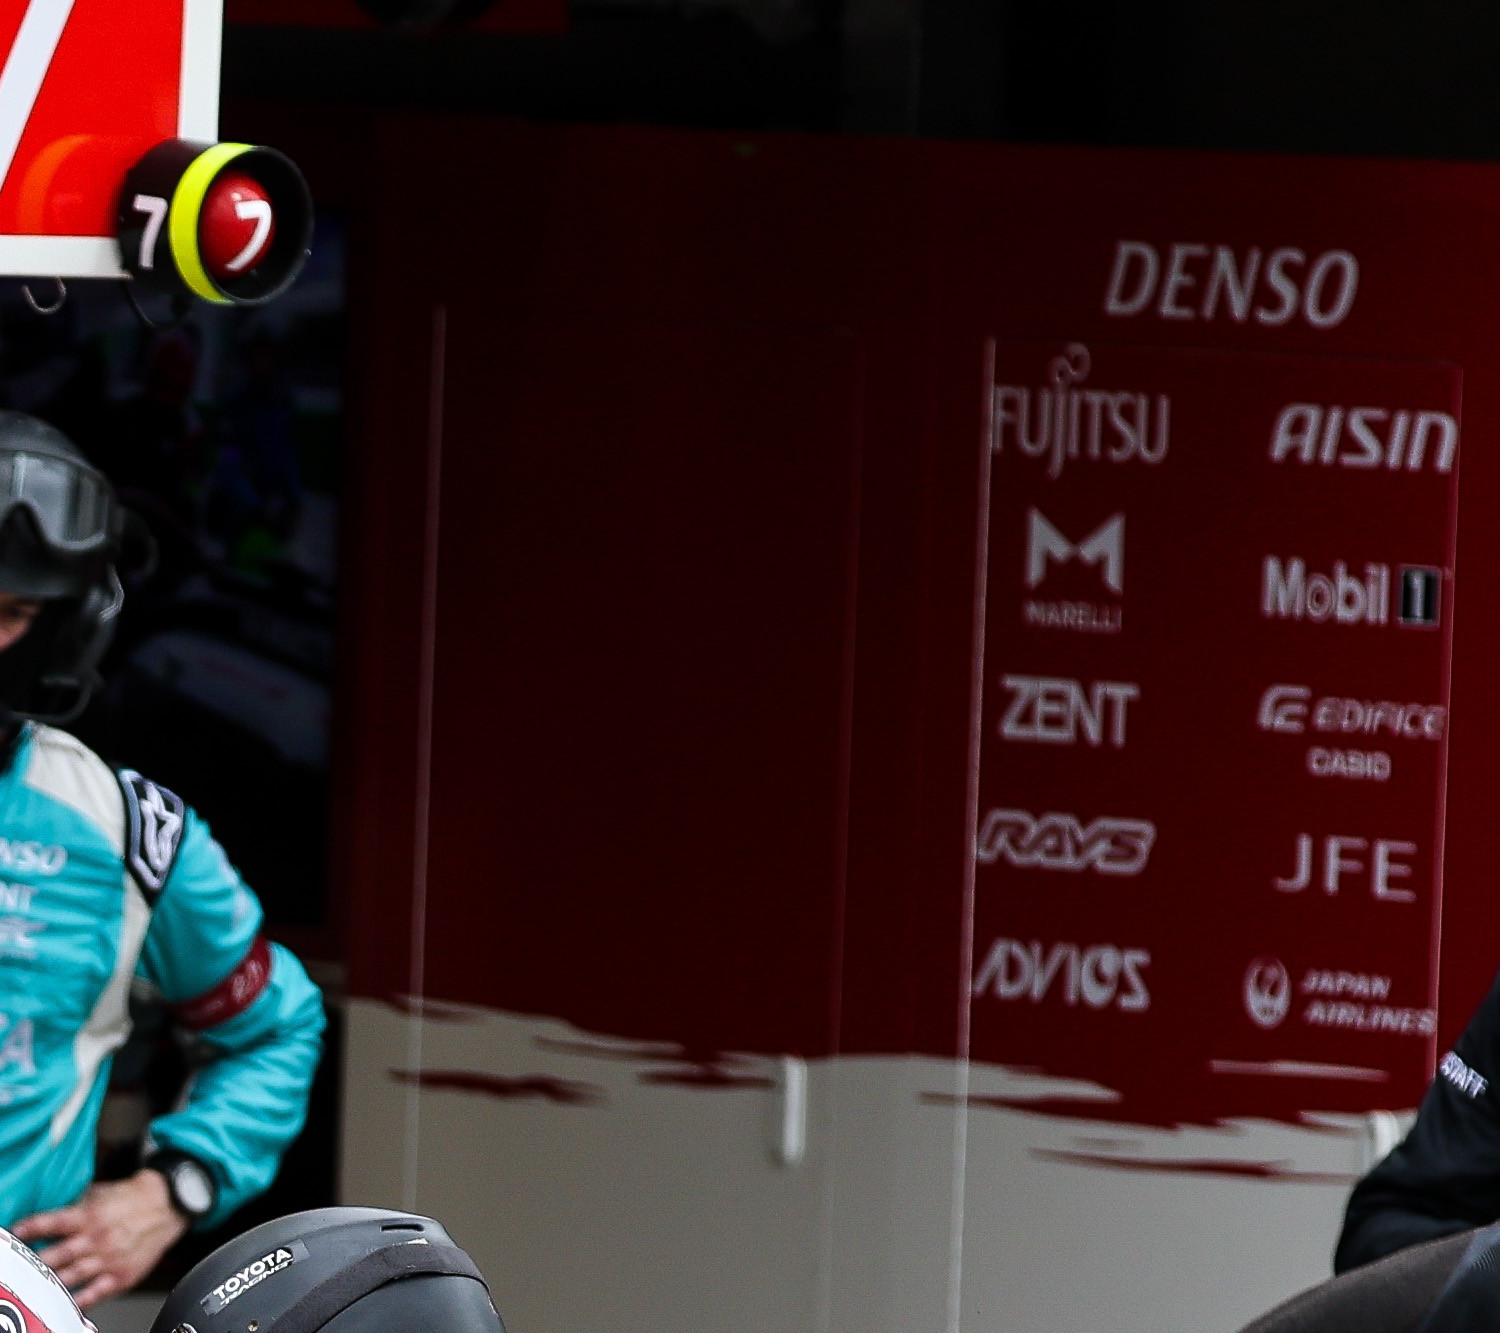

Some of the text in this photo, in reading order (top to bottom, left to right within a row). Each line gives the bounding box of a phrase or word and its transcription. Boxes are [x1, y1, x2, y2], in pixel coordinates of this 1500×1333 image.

[133, 195, 167, 269] 7
[228, 199, 271, 271] 7
[1105, 239, 1358, 328] DENSO
[992, 343, 1171, 480] FUJITSU
[1269, 403, 1458, 474] AISIN
[1023, 600, 1121, 632] MARELLI
[1261, 554, 1389, 626] Mobil
[1001, 674, 1140, 747] ZENT
[1313, 698, 1446, 741] EDIFICE
[1308, 748, 1391, 782] CASIO
[979, 809, 1156, 875] RAYS
[1274, 832, 1417, 902] JFE
[1303, 970, 1390, 998] JAPAN
[1305, 1004, 1435, 1036] AIRLINES
[213, 1248, 292, 1301] TOYOTA
[219, 1260, 295, 1306] RACING
